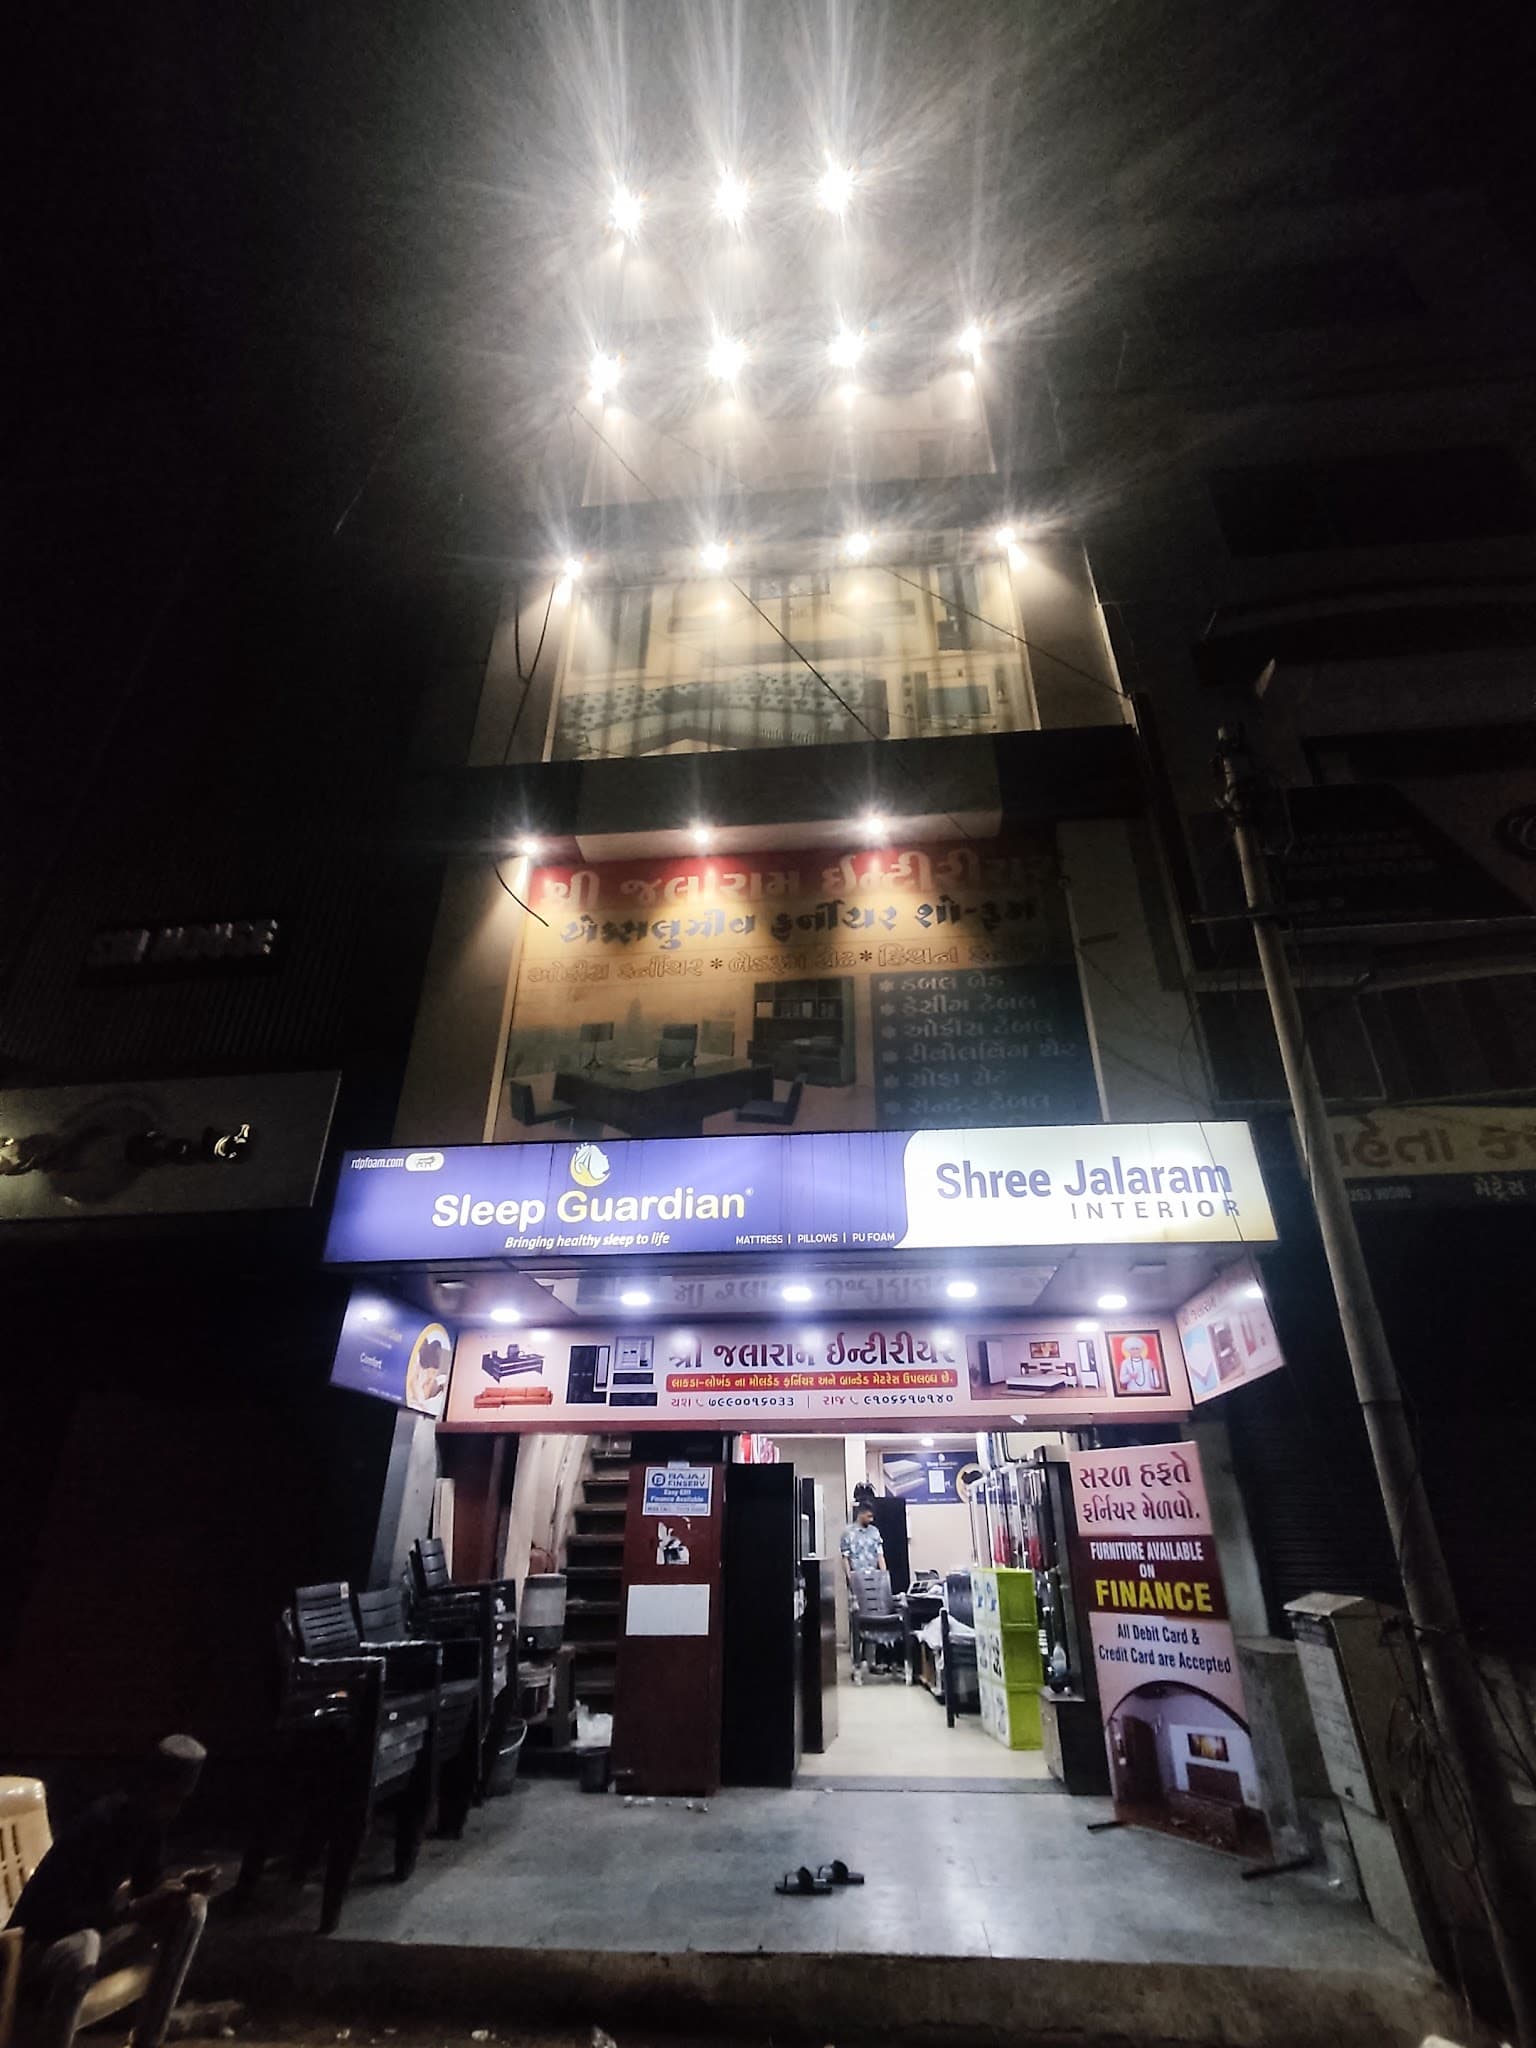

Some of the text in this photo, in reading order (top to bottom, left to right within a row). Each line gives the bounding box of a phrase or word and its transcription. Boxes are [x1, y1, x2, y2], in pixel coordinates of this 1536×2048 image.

[351, 1157, 405, 1170] rdpfoam.com
[936, 1156, 1233, 1199] Shree Jalaram
[431, 1186, 745, 1233] Sleep Guardian
[1071, 1199, 1241, 1220] INTERIOR
[504, 1231, 670, 1249] Bringing healthy sleep to life
[735, 1232, 896, 1245] MATTRESS PILLOWS PU FOAM
[735, 1379, 746, 1387] ના
[822, 1395, 845, 1406] રાજ
[1079, 1466, 1131, 1489] સરળ
[1083, 1490, 1200, 1523] ફર્નિચર મેળવો.
[1090, 1541, 1204, 1561] FURNITURE AVAILABLE
[1139, 1563, 1156, 1579] ON
[1095, 1579, 1214, 1612] FINANCE
[1117, 1623, 1200, 1645] All Debit Card &
[1098, 1645, 1231, 1674] Credit Card are Accepted
